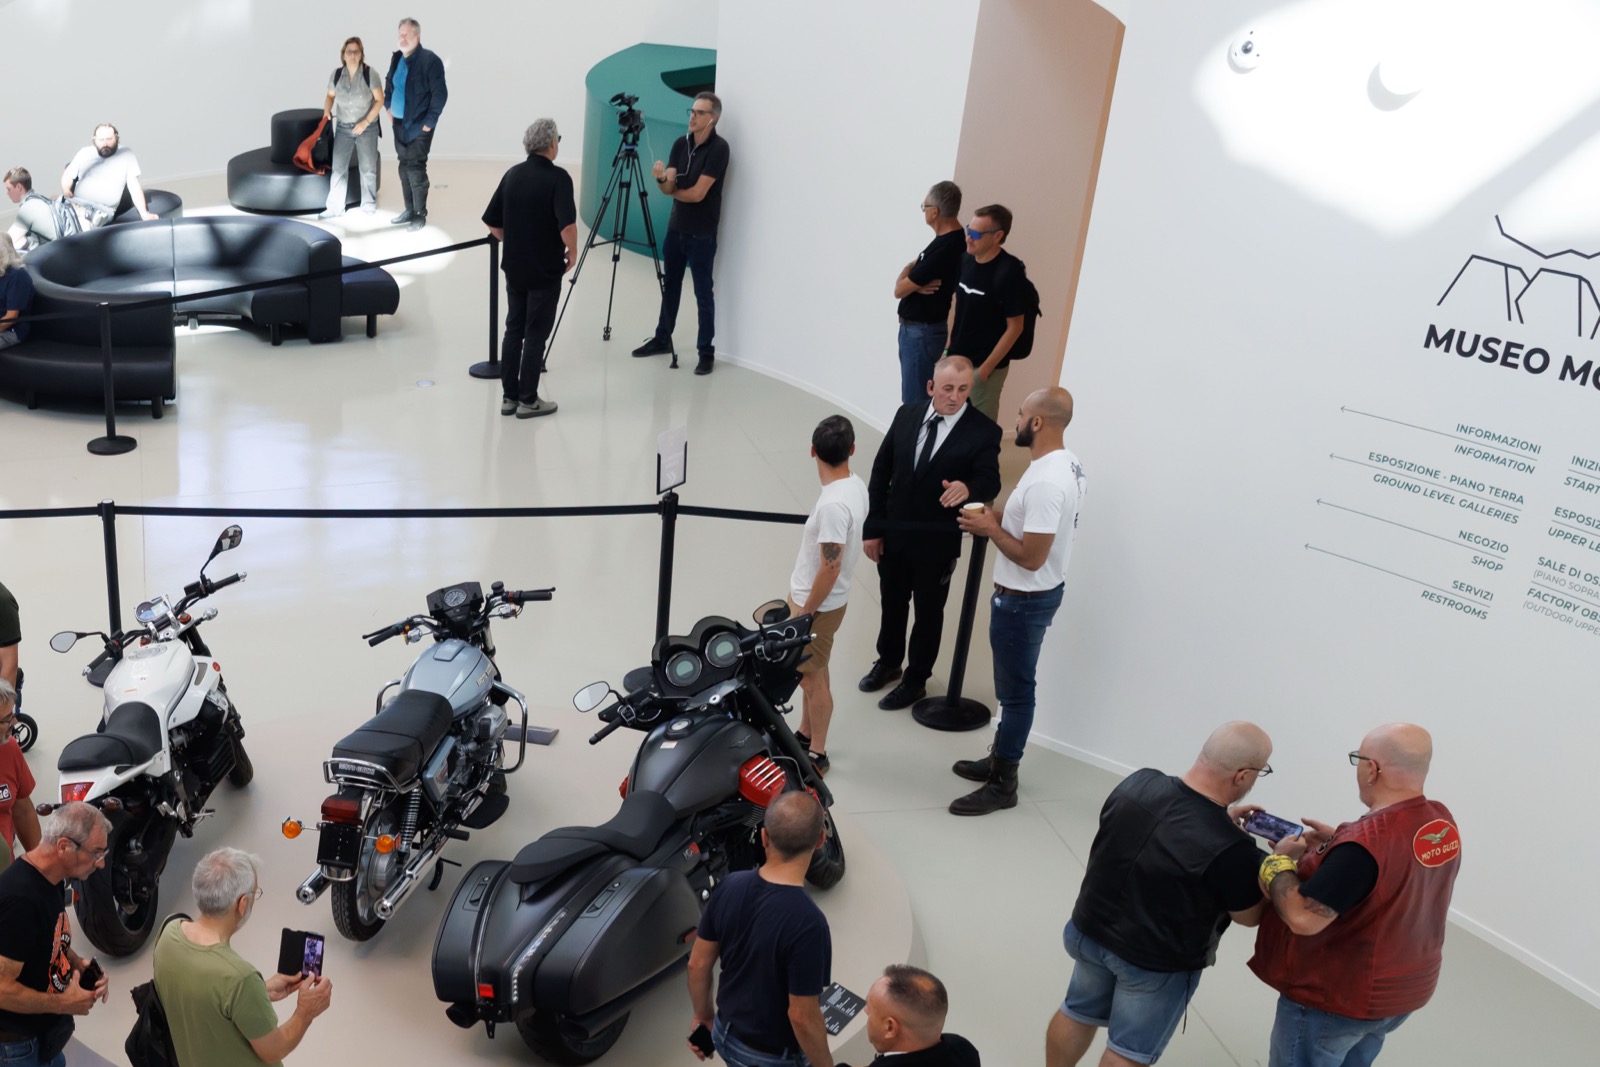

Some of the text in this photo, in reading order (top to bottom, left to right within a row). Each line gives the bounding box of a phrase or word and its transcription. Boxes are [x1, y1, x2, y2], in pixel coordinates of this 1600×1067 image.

[1423, 324, 1600, 391] MUSEO M
[1456, 423, 1541, 454] INFORMAZIONI
[1454, 444, 1535, 474] INFORMATION
[1571, 455, 1600, 473] INIZI
[1368, 452, 1441, 480] ESPOSIZIONE
[1449, 475, 1486, 493] PIANO
[1489, 486, 1524, 505] TERRA
[1564, 476, 1600, 494] START
[1373, 473, 1520, 525] GROUND LEVEL GALLERIES
[1458, 530, 1509, 553] NEGOZIO
[1548, 527, 1587, 547] UPPER
[1471, 555, 1503, 572] SHOP
[1537, 556, 1600, 586] SALE DI OS
[1451, 580, 1494, 601] SERVIZI
[1533, 570, 1600, 600] (PIANO SOPRA
[1421, 590, 1488, 620] RESTROOMS
[1527, 588, 1580, 613] FACTORY
[1523, 600, 1600, 637] (OUTDOOR UPPE
[1421, 840, 1459, 861] MOTO GUZZI
